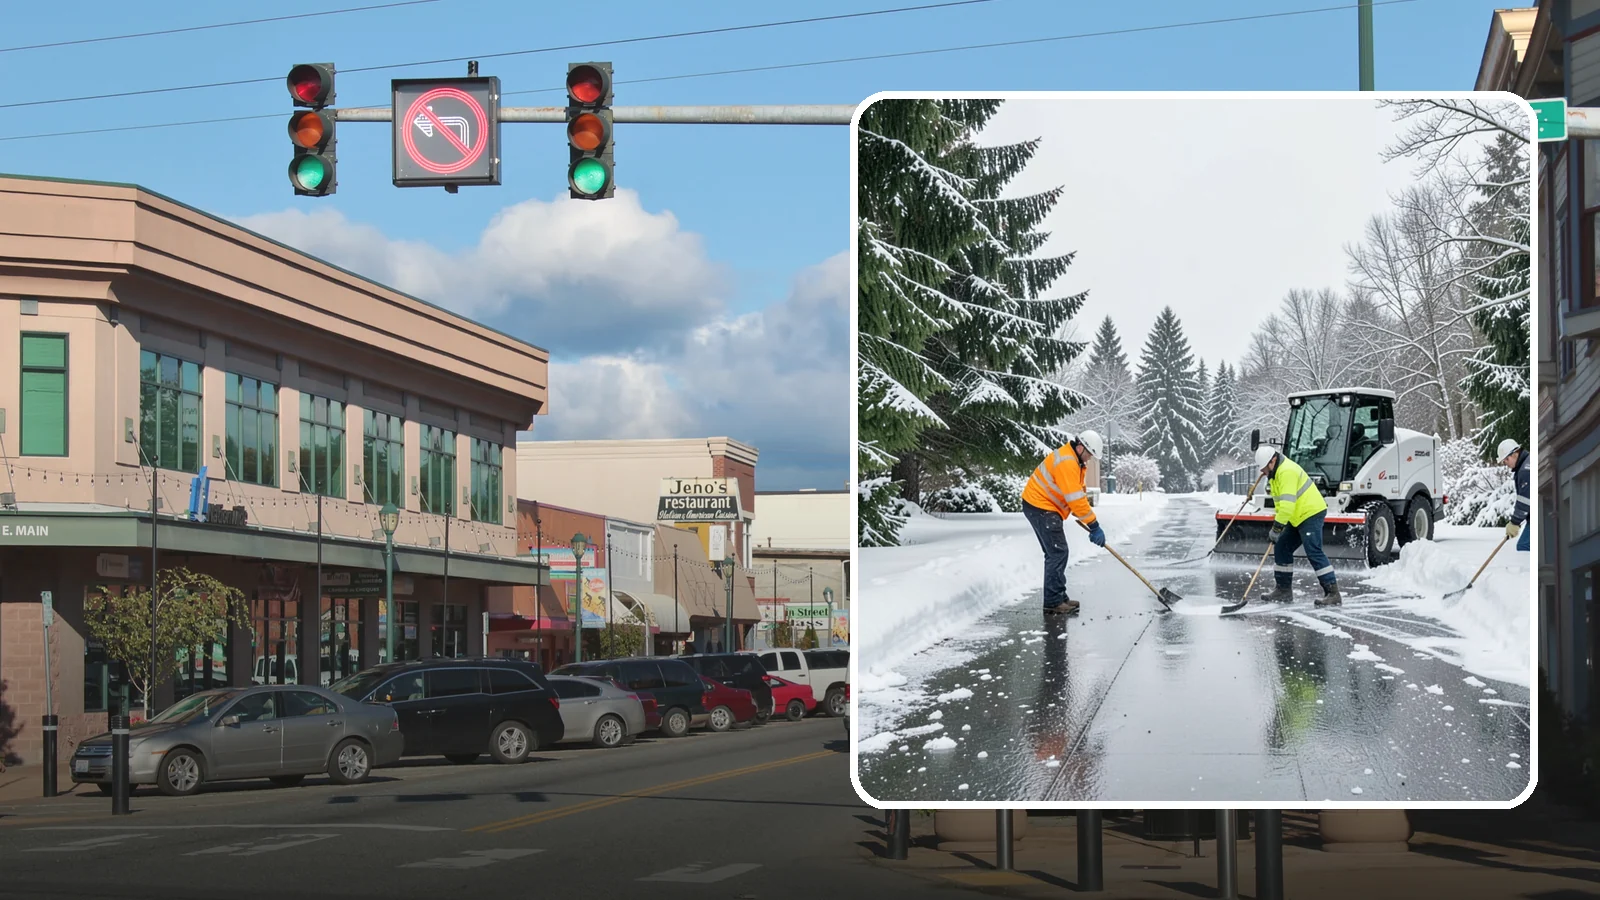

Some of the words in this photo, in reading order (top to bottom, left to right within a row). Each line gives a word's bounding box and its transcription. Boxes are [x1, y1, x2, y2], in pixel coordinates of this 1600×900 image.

[669, 480, 728, 495] Jeno's
[664, 496, 732, 509] restaurant
[658, 509, 682, 520] Italian
[686, 509, 715, 519] American
[715, 509, 738, 519] Cuisine
[2, 525, 14, 536] E.
[16, 525, 49, 536] MAIN
[797, 607, 829, 617] Street
